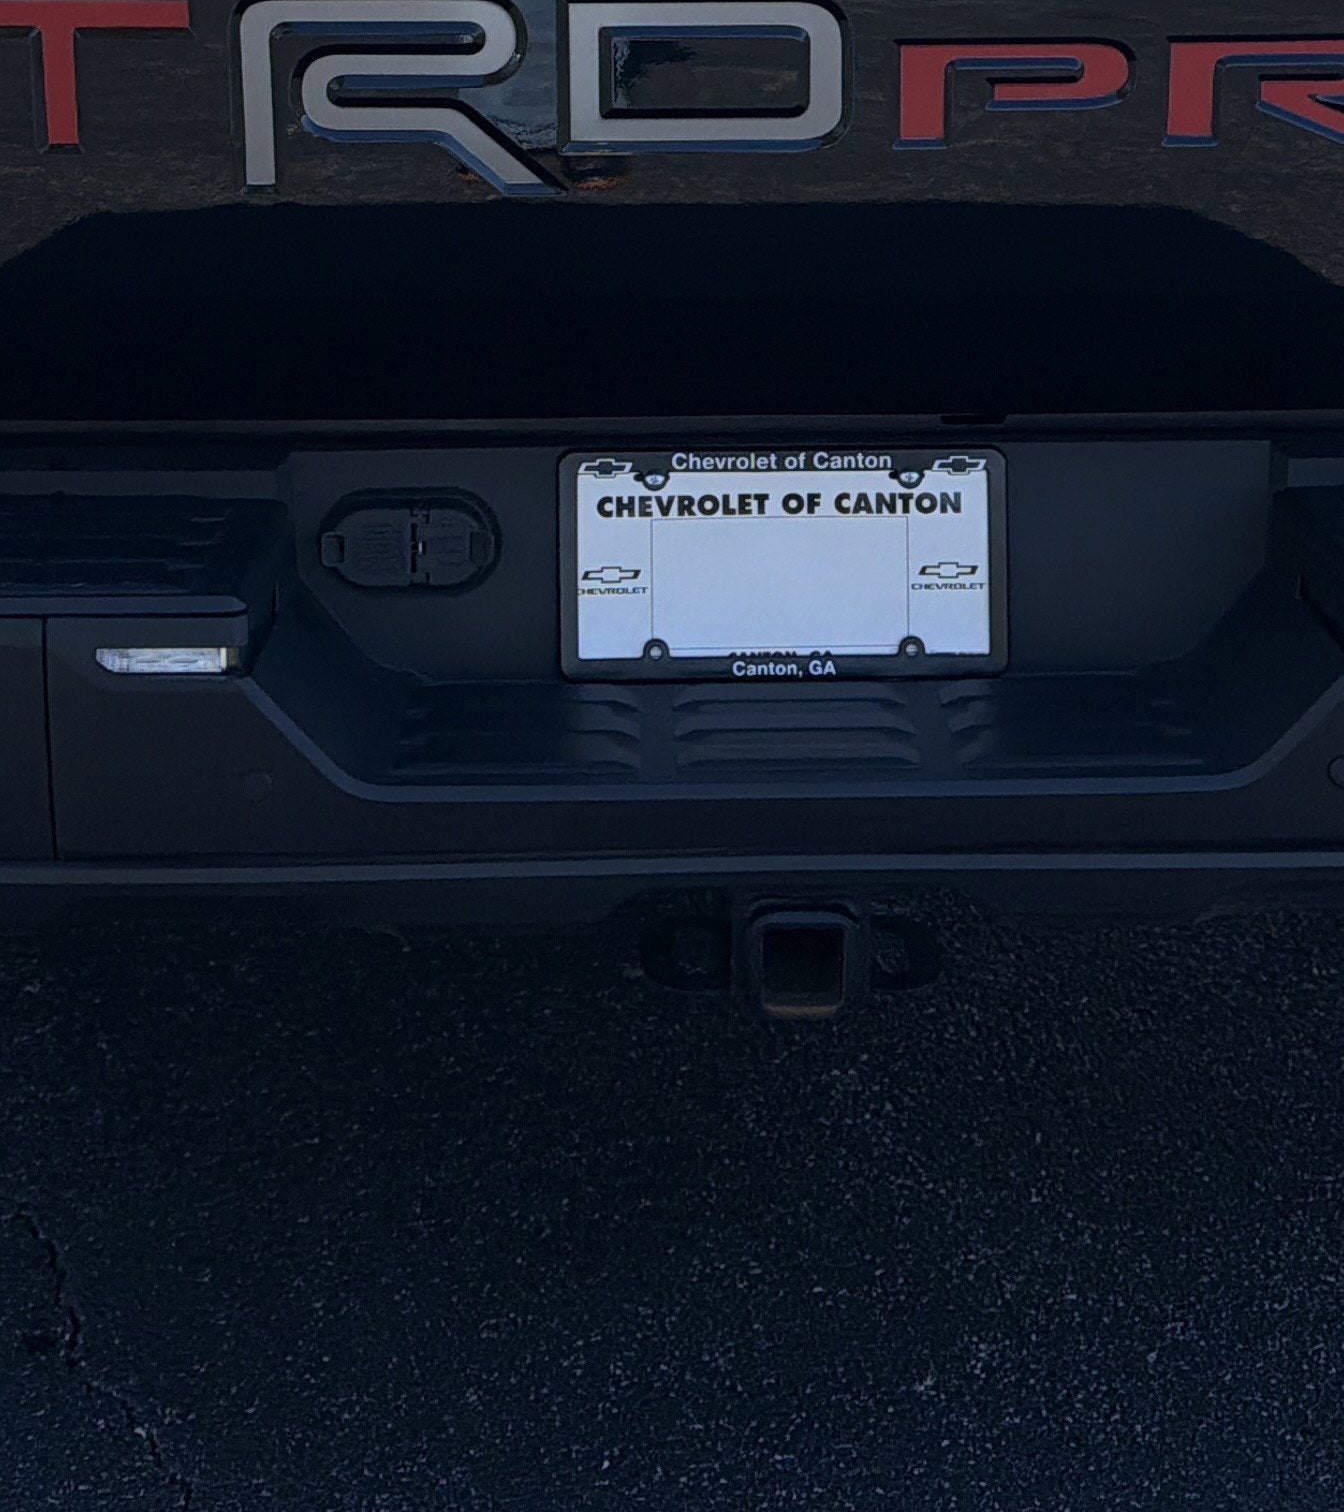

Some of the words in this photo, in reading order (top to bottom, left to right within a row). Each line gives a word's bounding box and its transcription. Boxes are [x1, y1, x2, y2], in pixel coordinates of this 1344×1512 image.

[670, 453, 777, 471] Chevrolet
[786, 452, 807, 470] of
[816, 452, 892, 470] Canton
[596, 493, 770, 518] CHEVROLET
[782, 493, 822, 516] OF
[833, 491, 962, 515] CANTON
[732, 660, 803, 677] Canton,
[808, 659, 837, 676] GA
